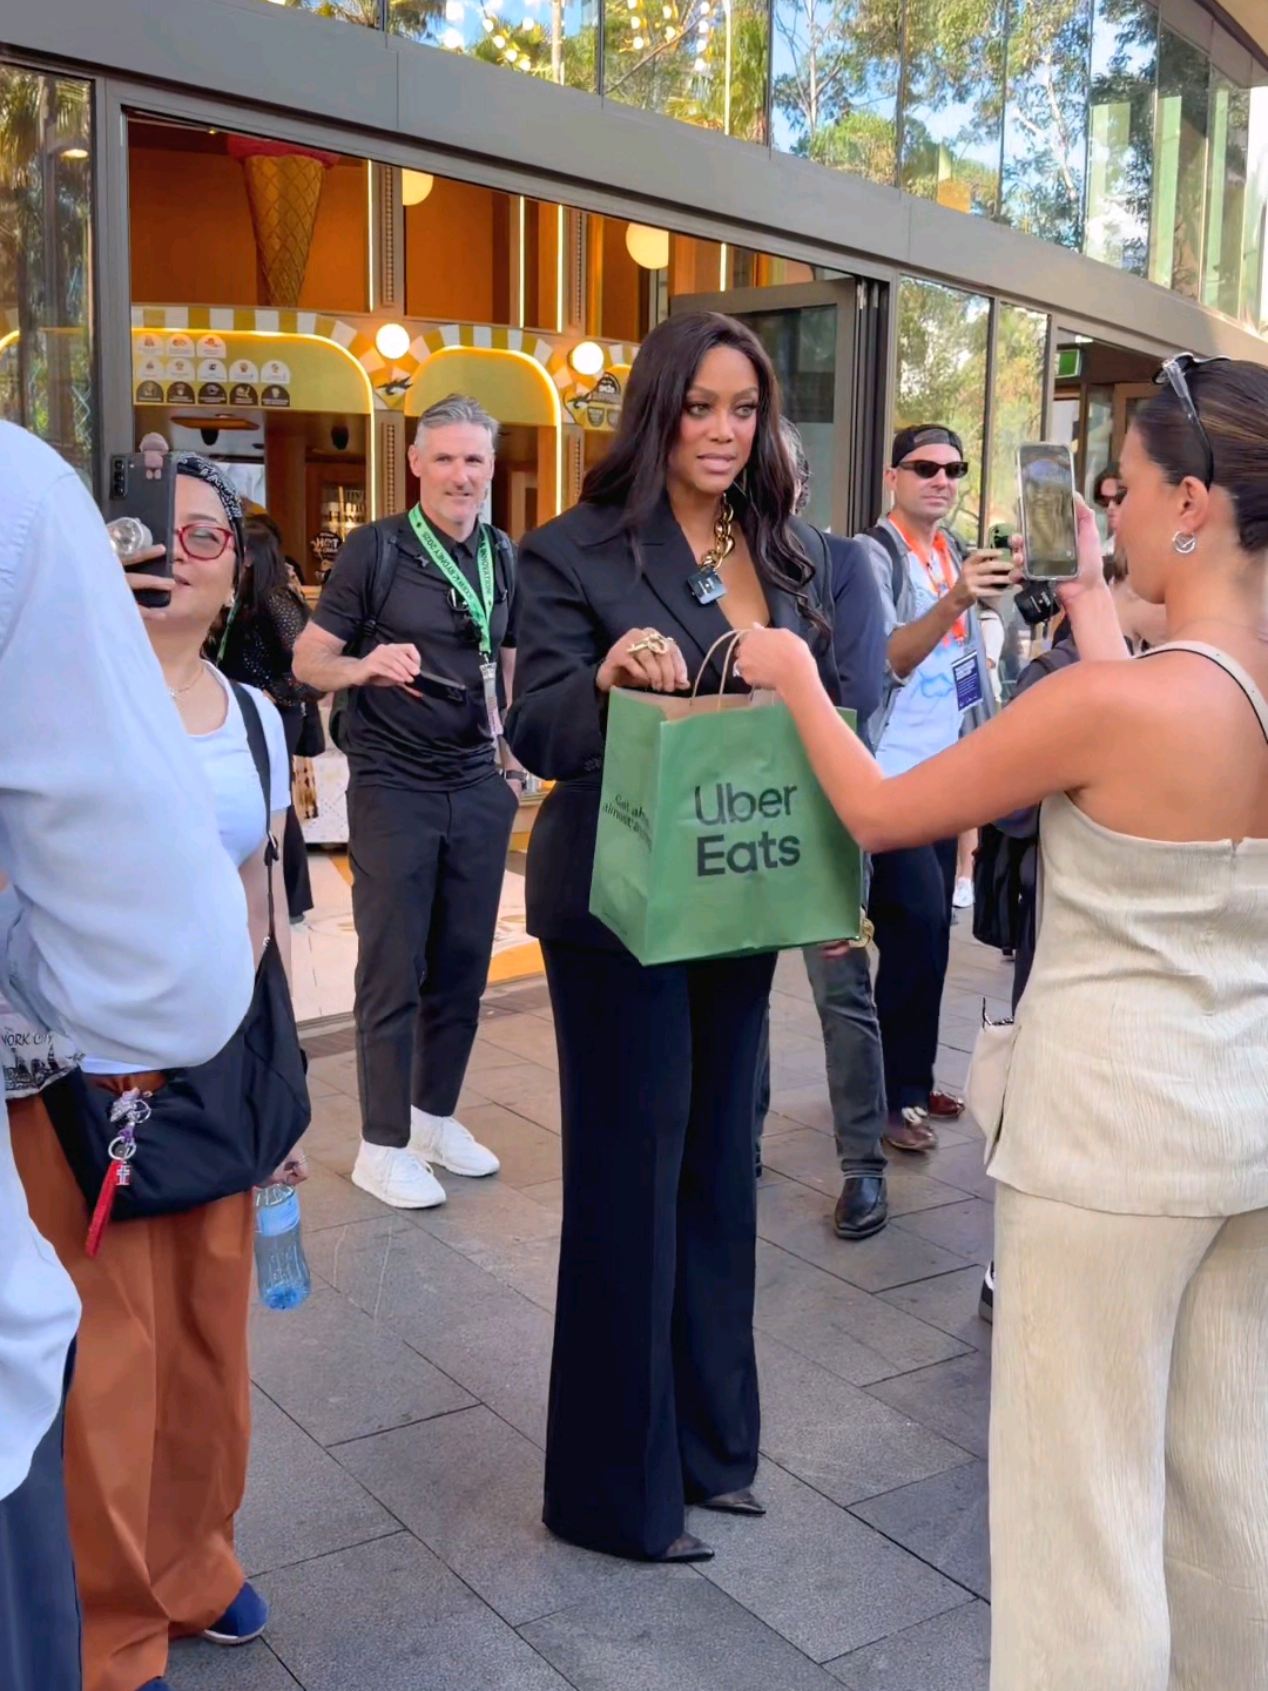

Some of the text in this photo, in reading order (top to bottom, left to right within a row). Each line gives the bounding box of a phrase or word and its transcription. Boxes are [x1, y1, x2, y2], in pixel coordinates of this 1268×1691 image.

[432, 547, 456, 576] SYDNEY
[694, 782, 798, 826] Uber
[697, 830, 801, 877] Eats
